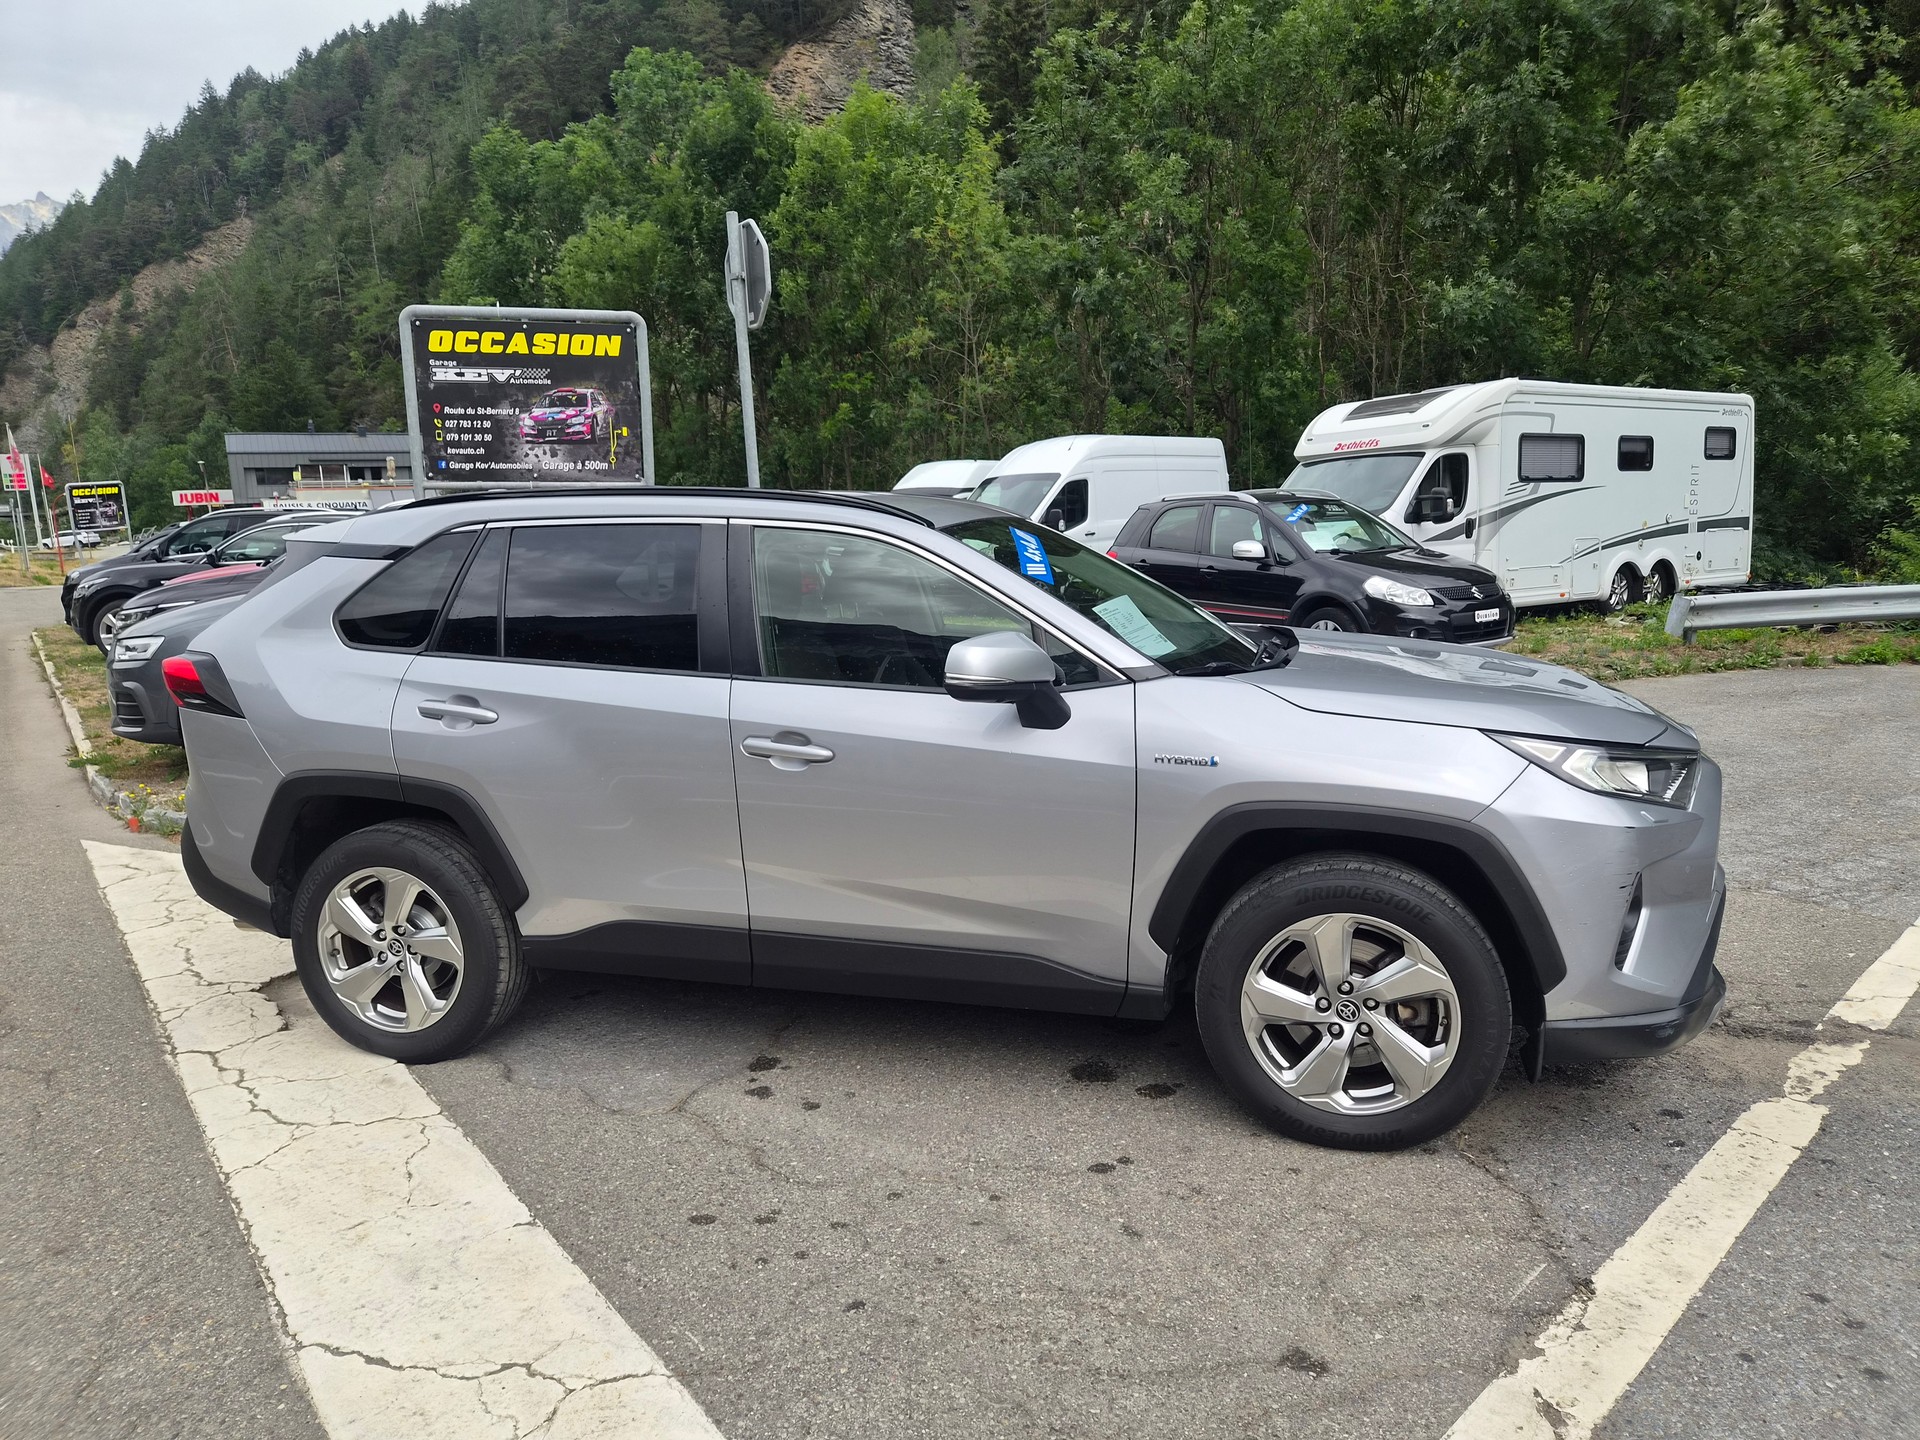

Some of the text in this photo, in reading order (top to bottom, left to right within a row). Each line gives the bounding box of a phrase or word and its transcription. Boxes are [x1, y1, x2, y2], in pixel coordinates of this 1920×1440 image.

[428, 330, 622, 357] OCCASION
[510, 377, 552, 385] Automobile
[444, 406, 520, 415] Route du St-Bernard 8
[445, 420, 492, 428] 027 783 12 50
[446, 433, 493, 442] 079 101 30 50
[447, 446, 485, 455] kevauto.ch
[449, 461, 533, 471] Garage Kev'Automobiles
[542, 461, 609, 471] Garage à 500m
[72, 487, 119, 496] OCCASION
[1689, 464, 1700, 515] ESPRIT
[179, 492, 220, 504] JUBIN
[316, 501, 368, 509] CINQUANTA
[1154, 753, 1209, 767] HYBRID
[1295, 884, 1438, 926] BRIDGESTONE
